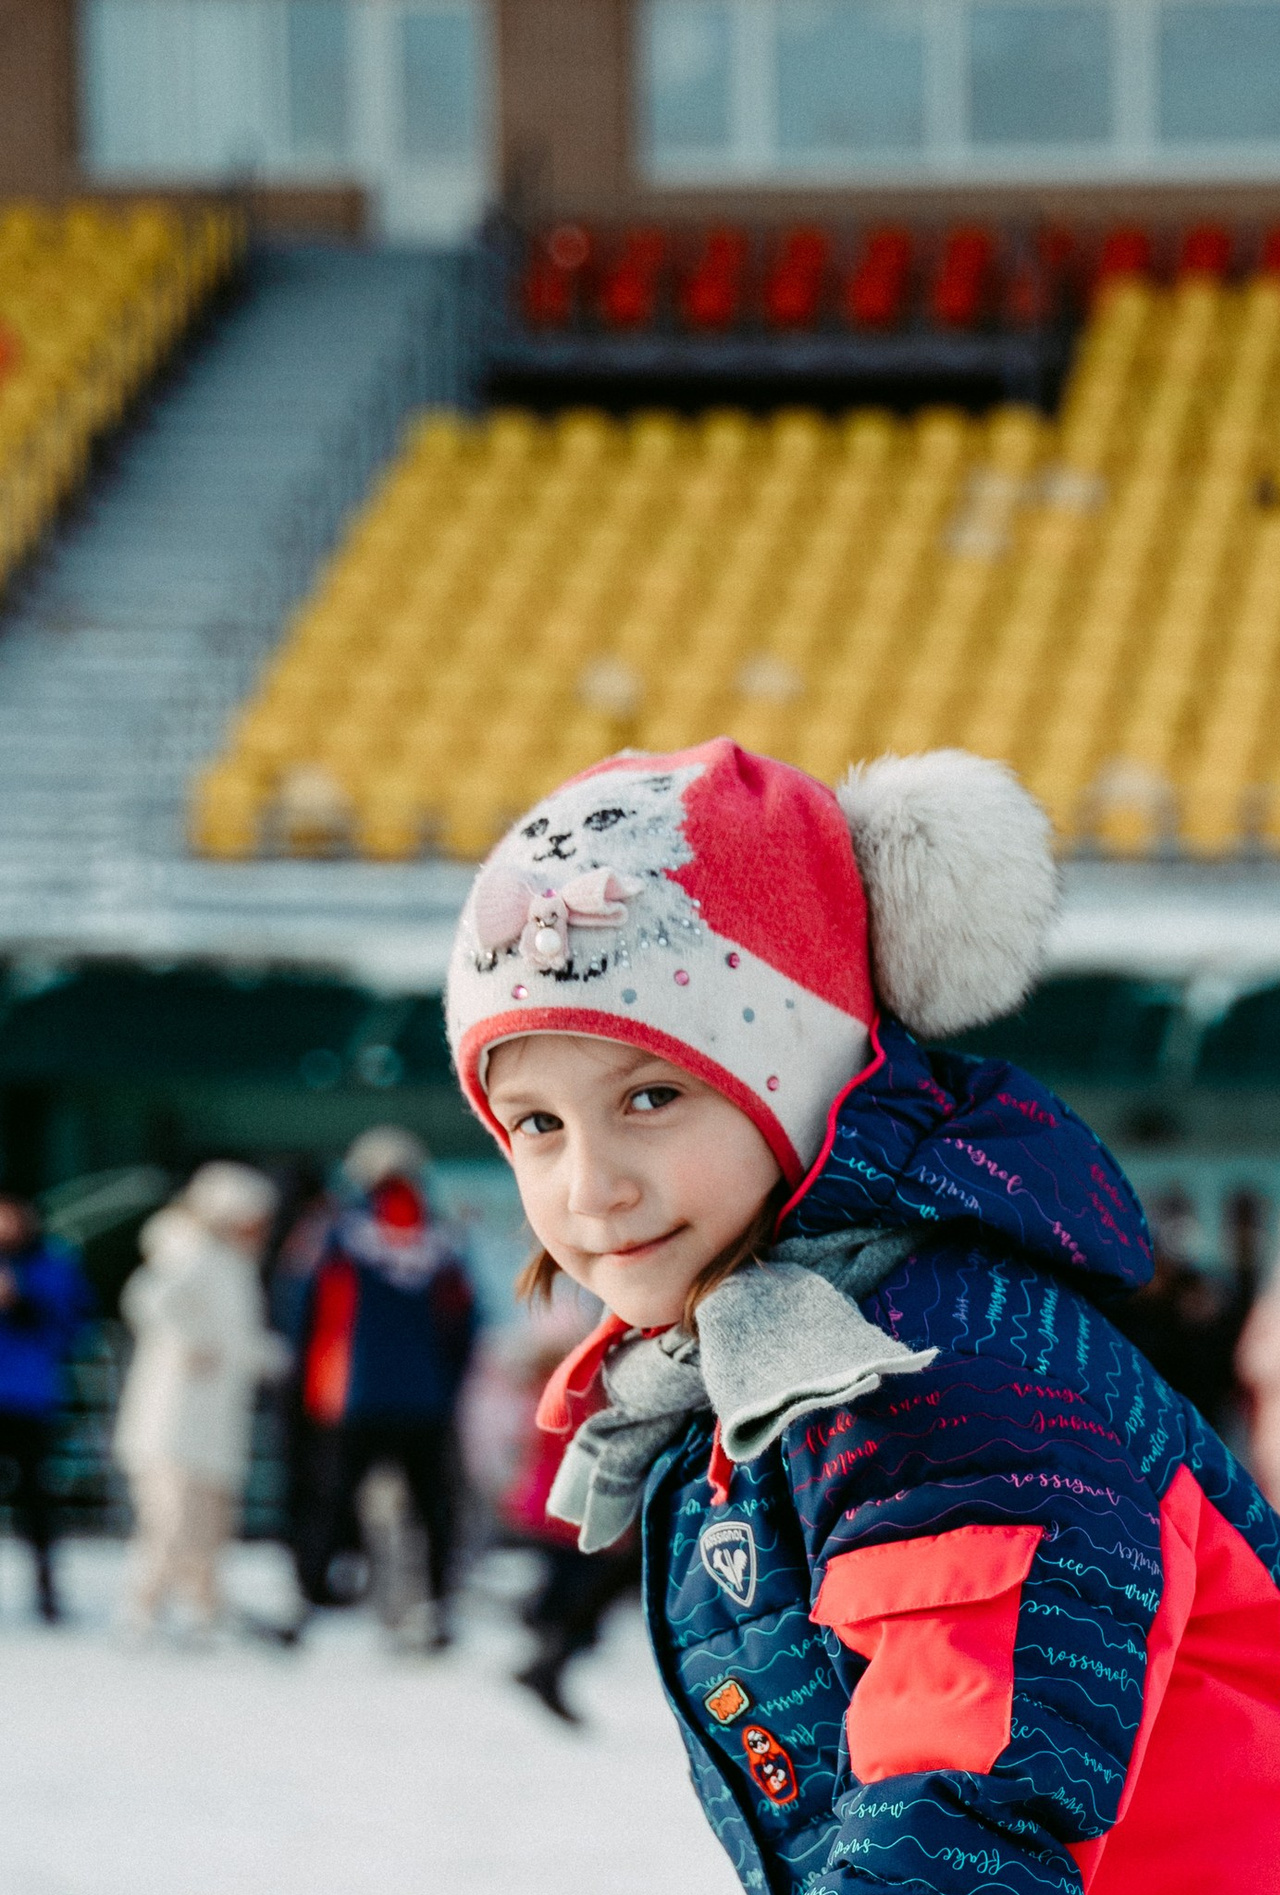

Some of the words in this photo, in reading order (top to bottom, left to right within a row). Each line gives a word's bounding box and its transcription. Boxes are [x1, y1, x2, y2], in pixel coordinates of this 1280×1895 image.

[849, 1157, 877, 1181] ice
[943, 1137, 1023, 1196] signol
[1011, 1472, 1116, 1506] rossignol
[1058, 1557, 1084, 1577] ice
[1027, 1599, 1060, 1616] ice
[1047, 1646, 1129, 1692] rossignol
[759, 1666, 831, 1717] rossignol
[856, 1800, 904, 1819] snow
[942, 1848, 1000, 1876] flake
